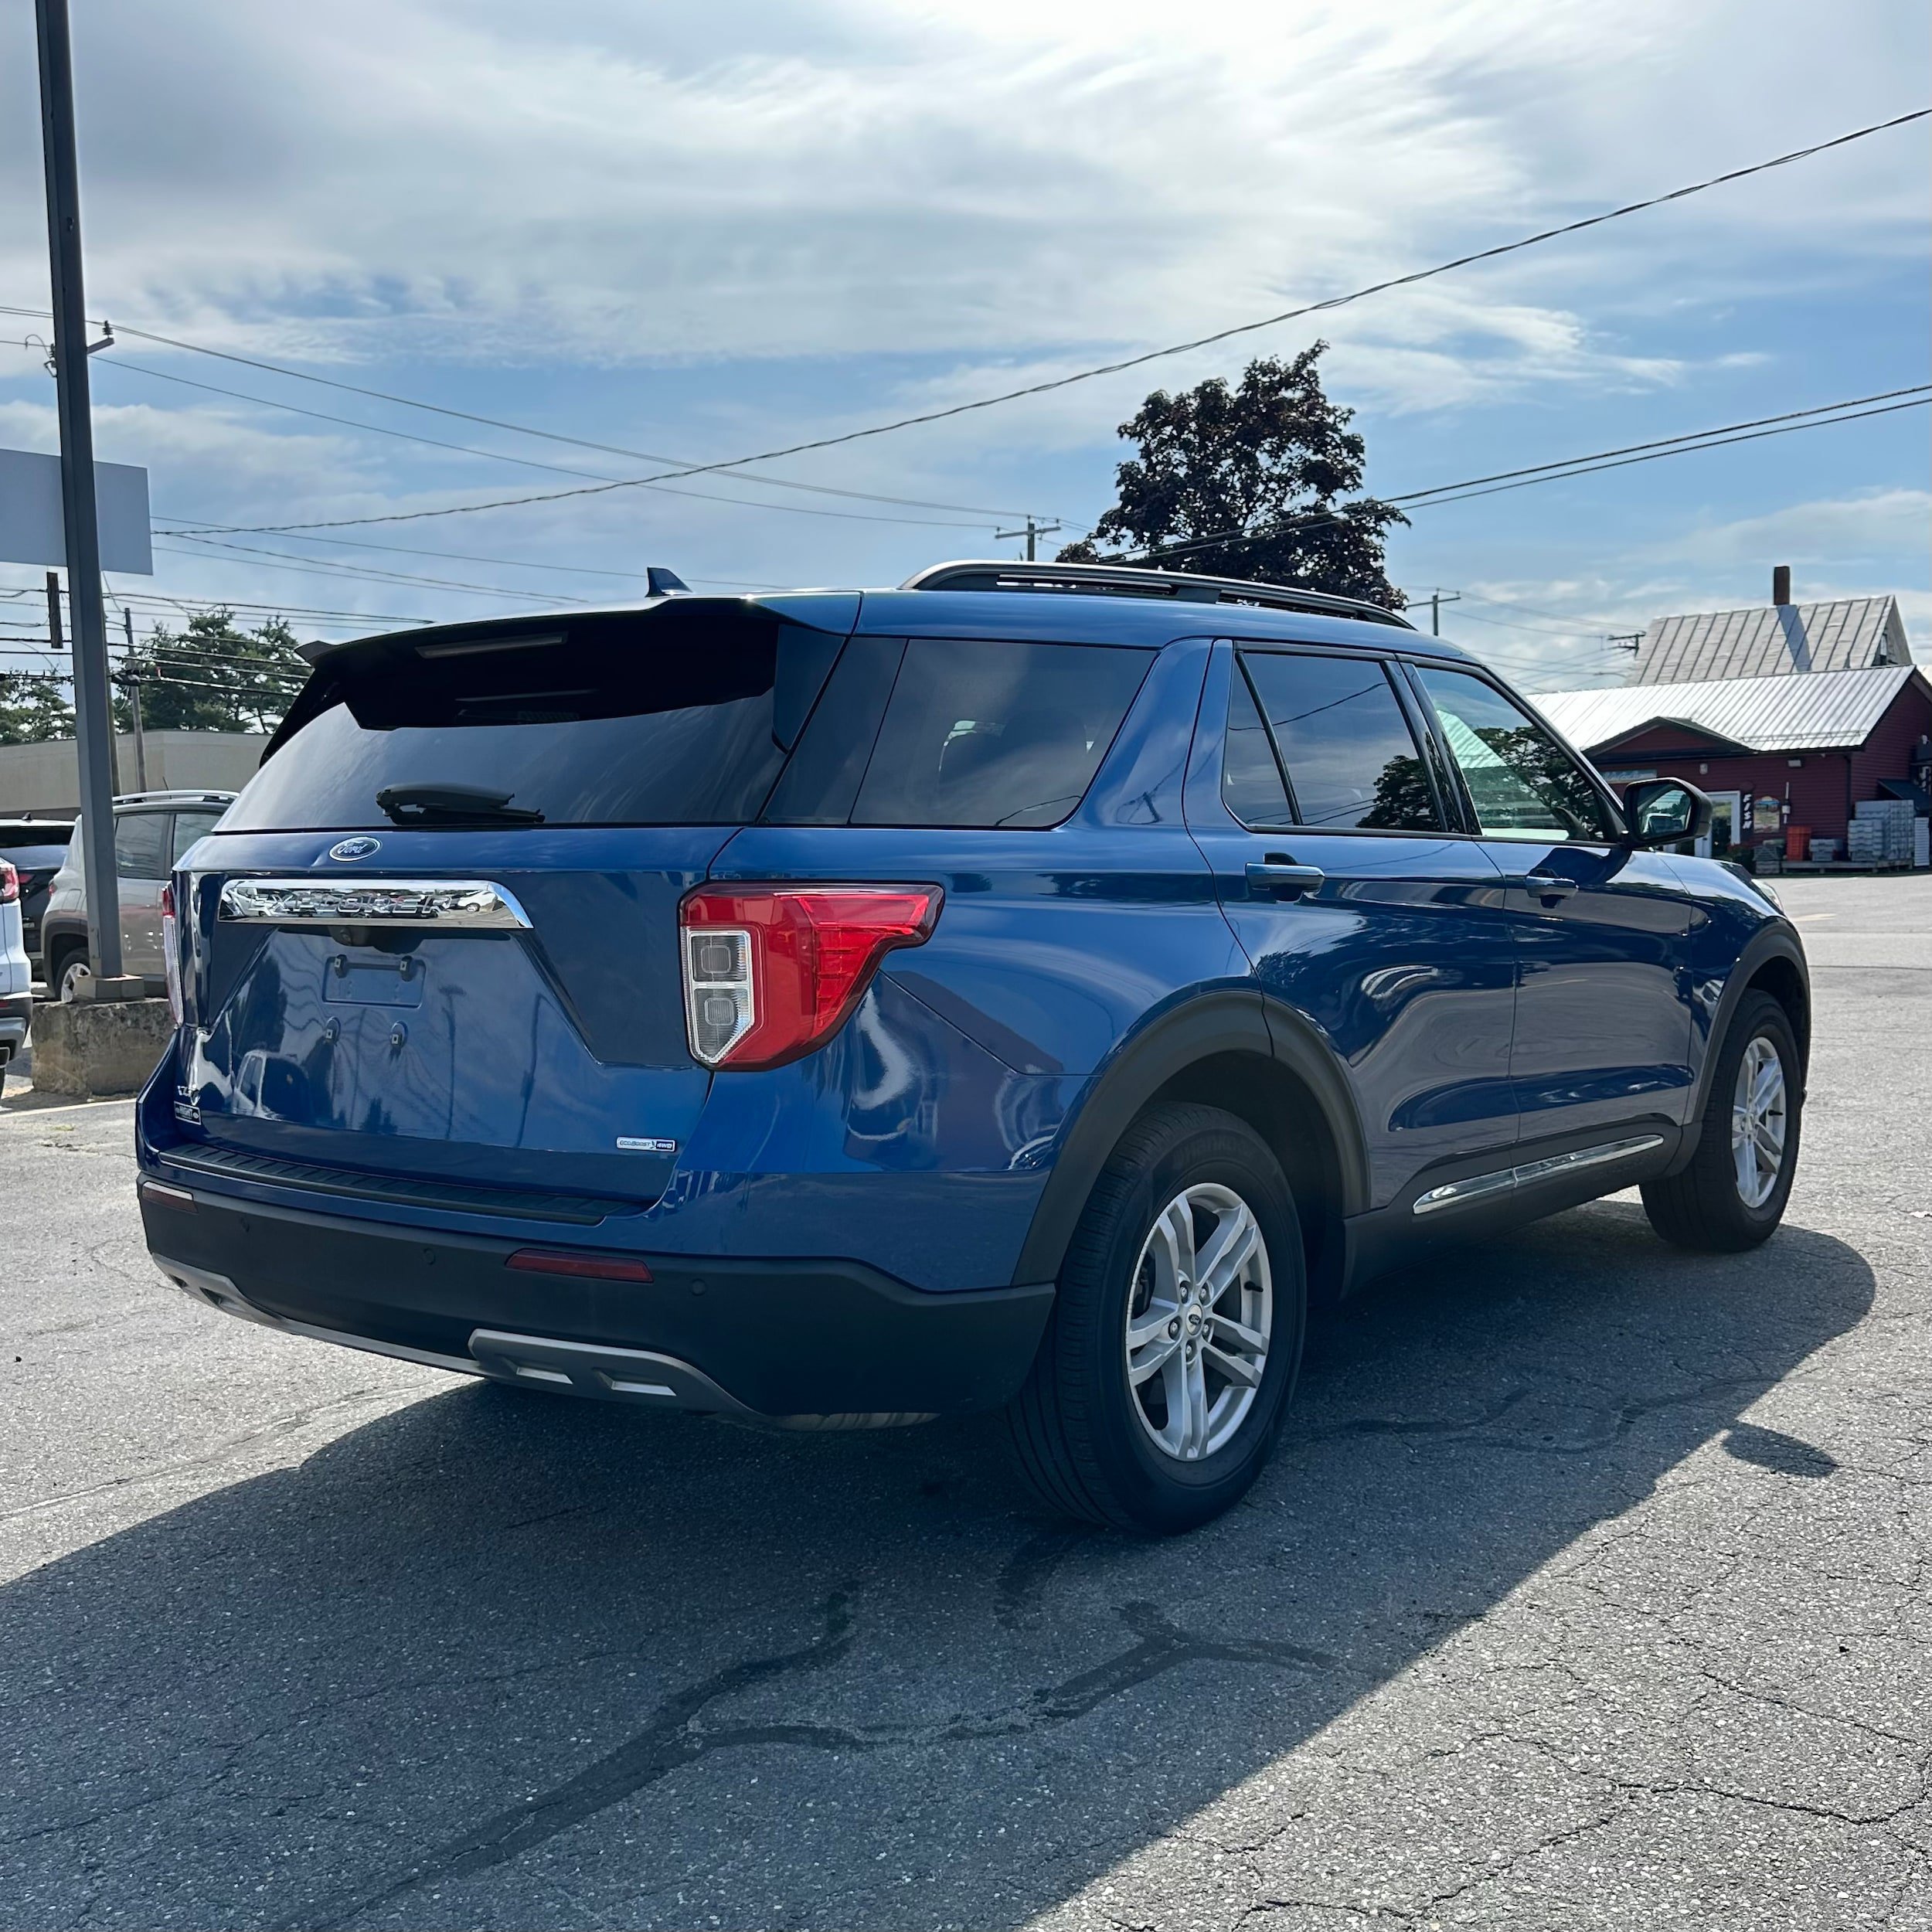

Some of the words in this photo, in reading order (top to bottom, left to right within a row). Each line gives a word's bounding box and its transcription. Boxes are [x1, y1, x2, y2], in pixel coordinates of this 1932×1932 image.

[1743, 794, 1753, 829] FISH
[337, 840, 369, 855] Ford
[247, 894, 451, 914] EXPLORER
